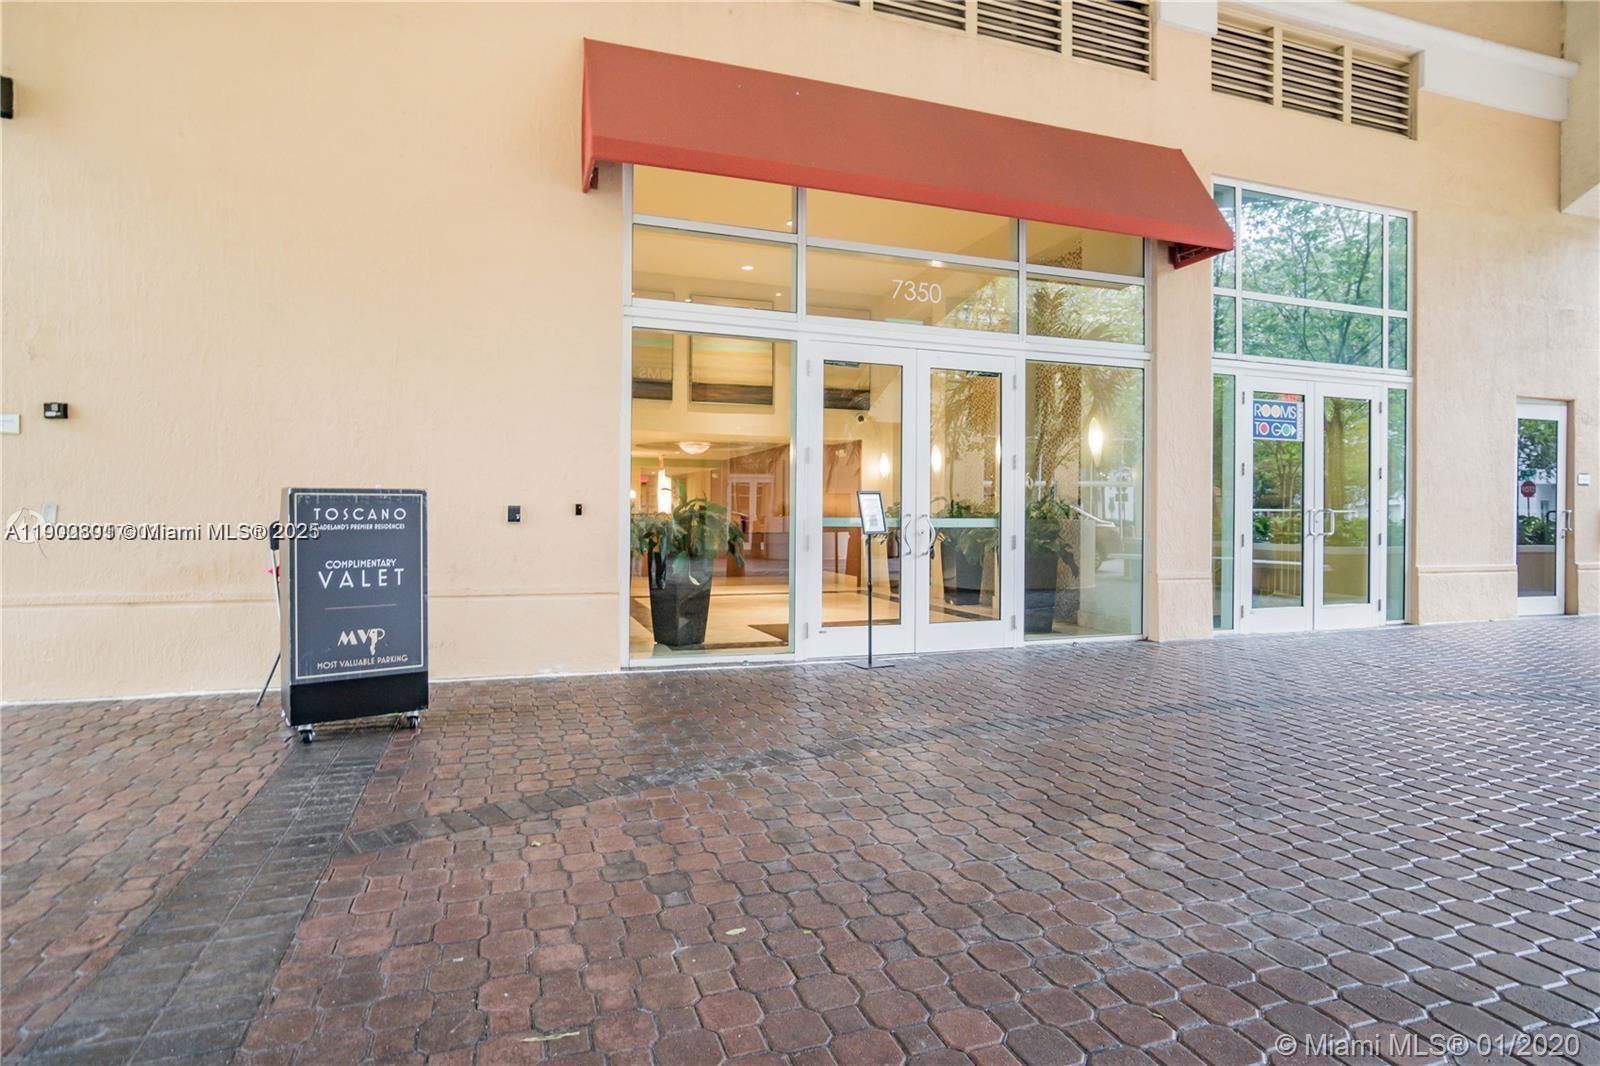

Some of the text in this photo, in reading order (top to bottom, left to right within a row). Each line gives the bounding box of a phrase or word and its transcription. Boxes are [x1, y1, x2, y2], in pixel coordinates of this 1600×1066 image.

[892, 279, 942, 303] 7350
[1254, 403, 1297, 419] ROOMS
[1254, 421, 1291, 437] TO GO
[314, 507, 407, 521] TOSCANO
[311, 523, 350, 531] ADELAND'S
[350, 523, 373, 531] PREMIER
[325, 558, 397, 569] COMPLIMENTARY
[318, 567, 405, 589] VALET
[337, 627, 386, 656] MVP
[317, 654, 408, 670] MOST VALUABLE PARKING
